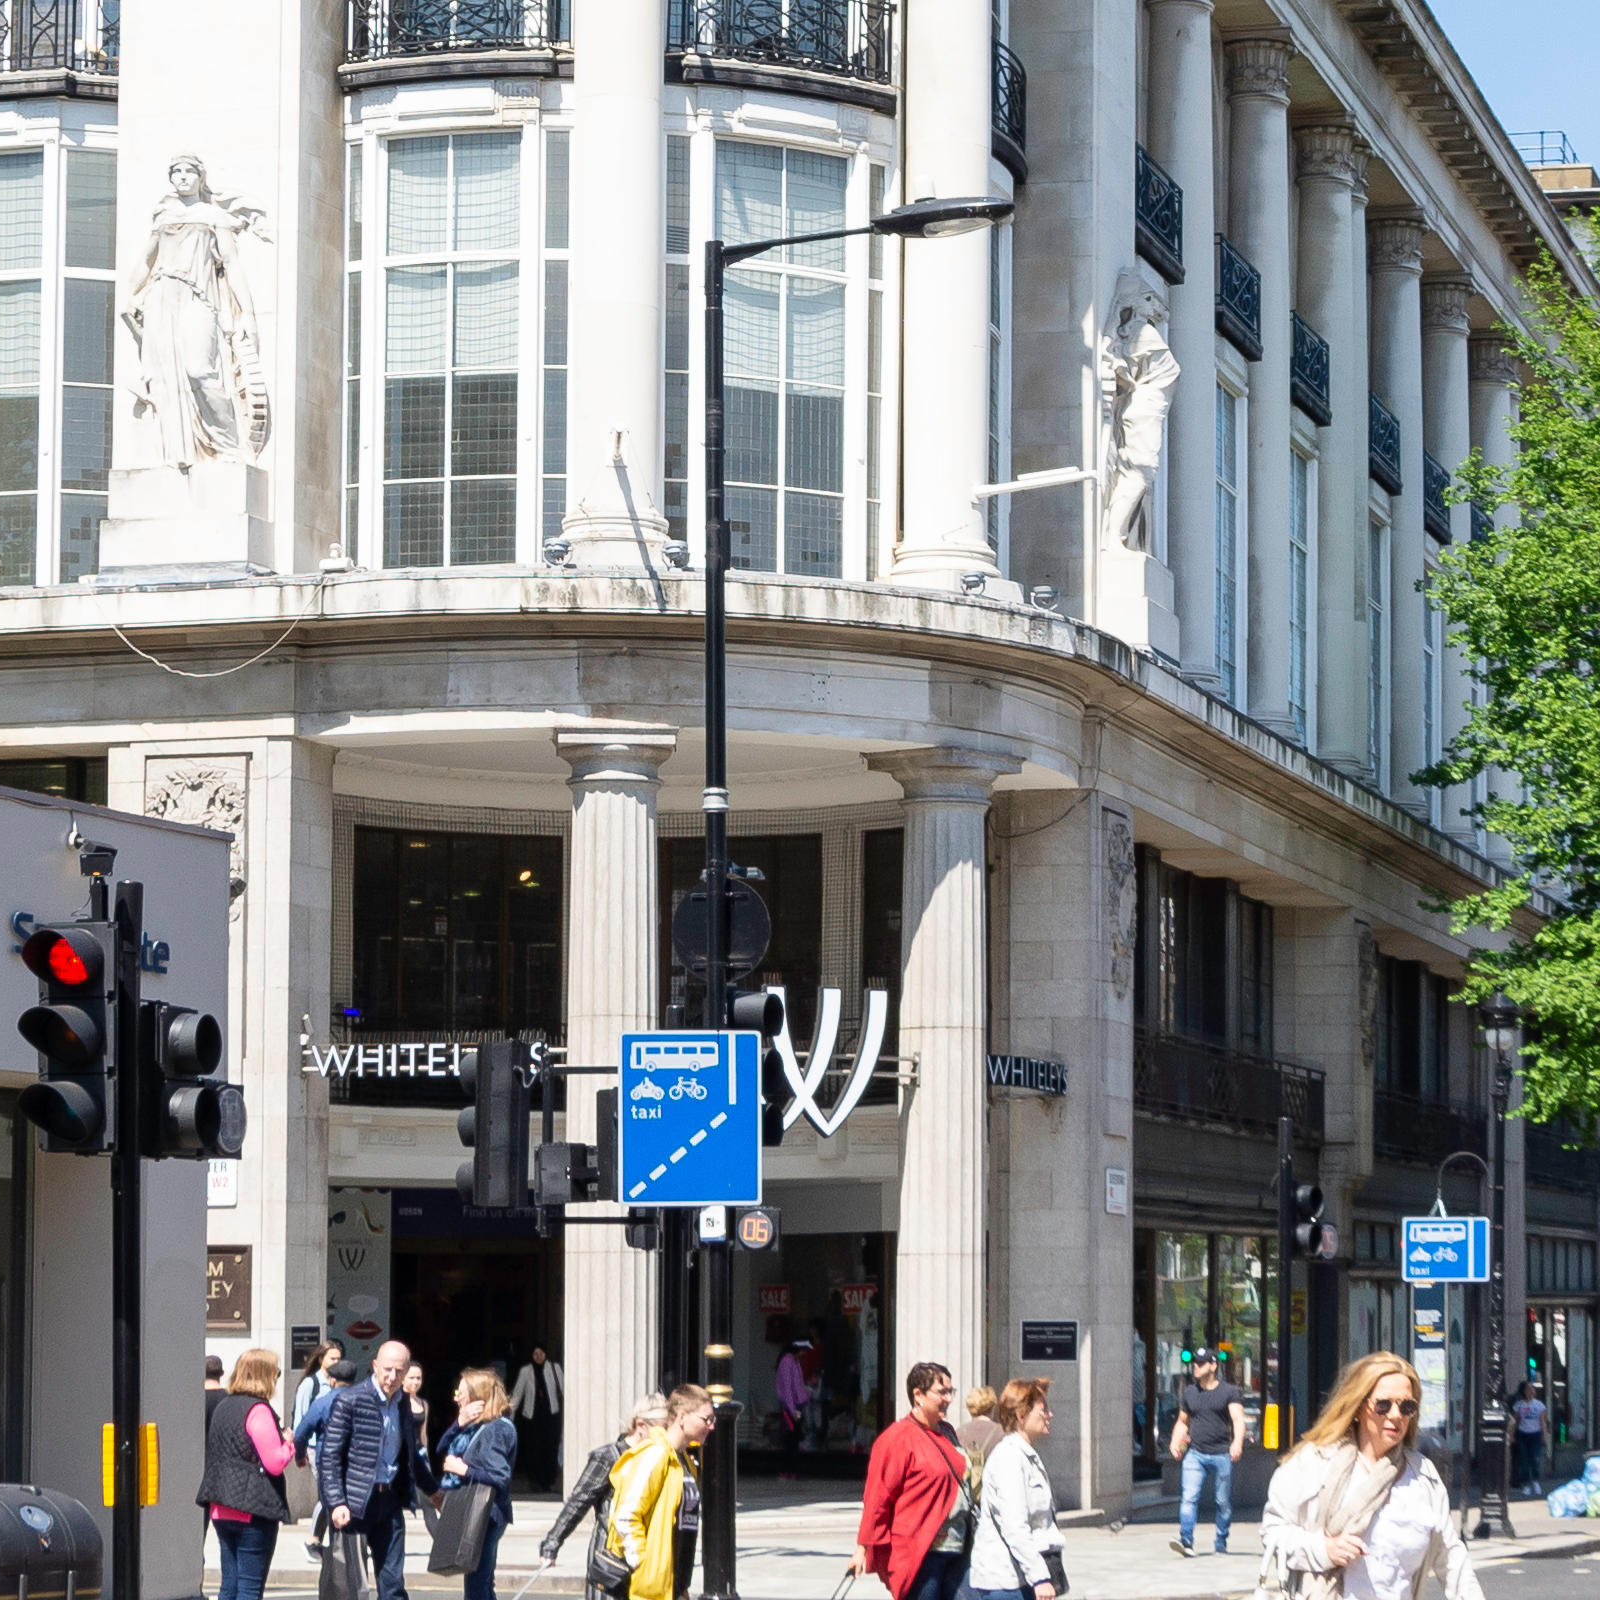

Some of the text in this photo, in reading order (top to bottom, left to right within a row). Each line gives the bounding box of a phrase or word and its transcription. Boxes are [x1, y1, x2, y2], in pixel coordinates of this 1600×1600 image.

[987, 1055, 1068, 1095] WHITELEYS
[631, 1104, 662, 1120] taxi
[211, 1176, 229, 1188] W2
[742, 1217, 769, 1242] 06
[760, 1288, 787, 1308] SALE
